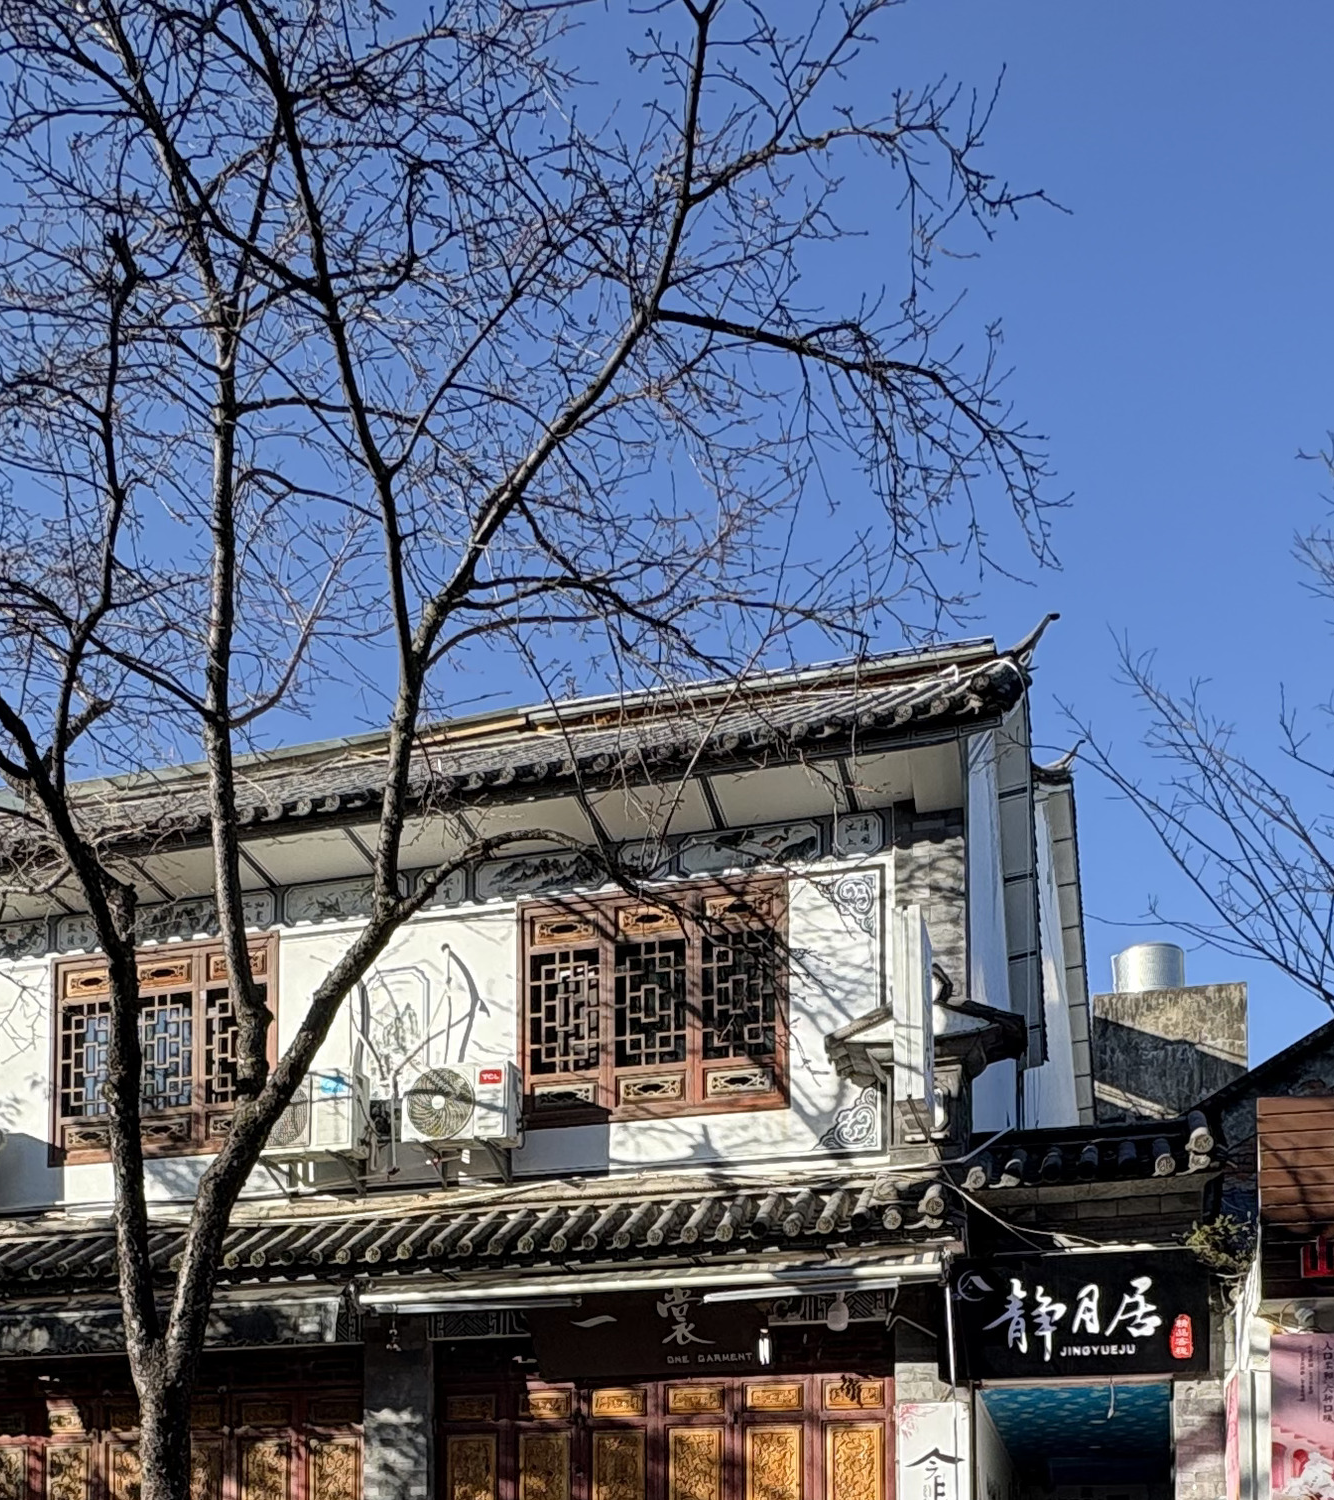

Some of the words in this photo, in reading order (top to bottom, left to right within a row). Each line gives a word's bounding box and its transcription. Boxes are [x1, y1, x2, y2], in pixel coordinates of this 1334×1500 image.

[481, 1073, 501, 1081] TCL
[983, 1276, 1162, 1362] 静月居
[1060, 1344, 1136, 1357] JINGYUEJU
[667, 1354, 690, 1365] ONE
[698, 1351, 753, 1363] GARMENT
